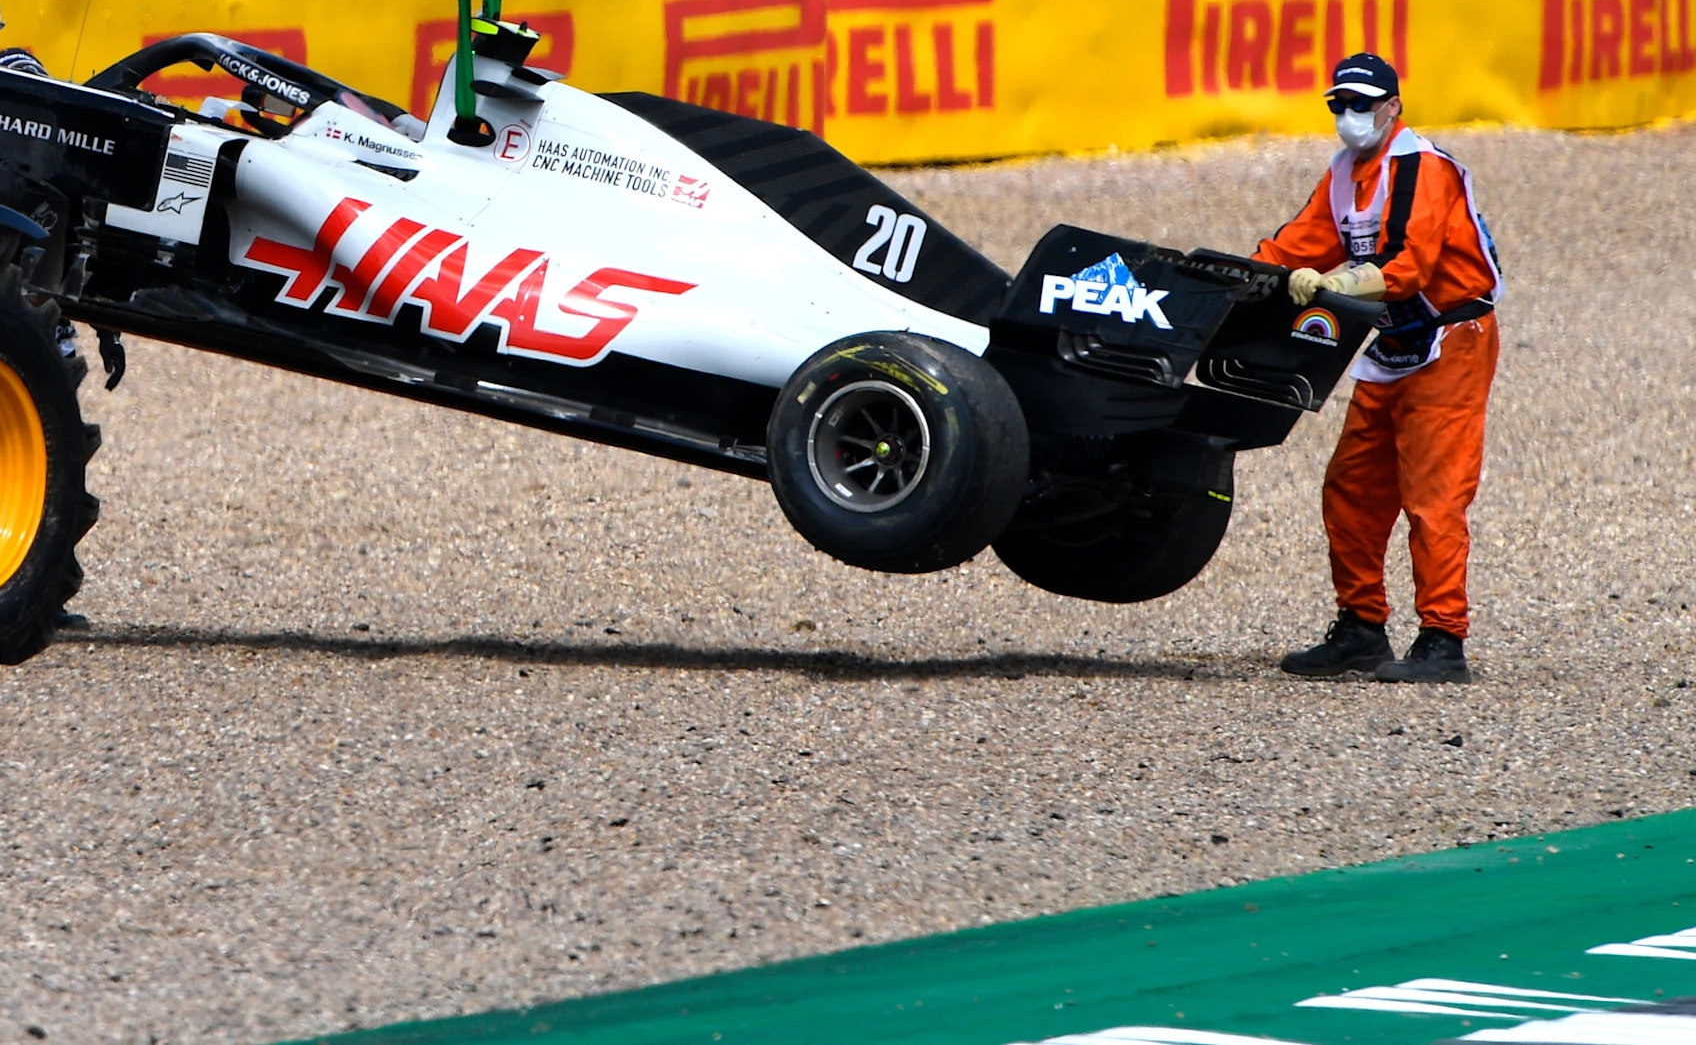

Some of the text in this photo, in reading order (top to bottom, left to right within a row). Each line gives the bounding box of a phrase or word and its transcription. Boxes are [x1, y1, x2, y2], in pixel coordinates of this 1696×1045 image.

[218, 53, 312, 105] JACK&JONES
[56, 128, 116, 155] MILLE
[343, 132, 355, 144] K.
[500, 130, 523, 160] E
[537, 139, 570, 158] HAAS
[570, 146, 647, 175] AUTOMATION
[532, 154, 669, 198] CNC MACHINE TOOLS
[852, 204, 928, 284] 20
[243, 196, 701, 360] HAAS
[1039, 274, 1173, 330] PEAK
